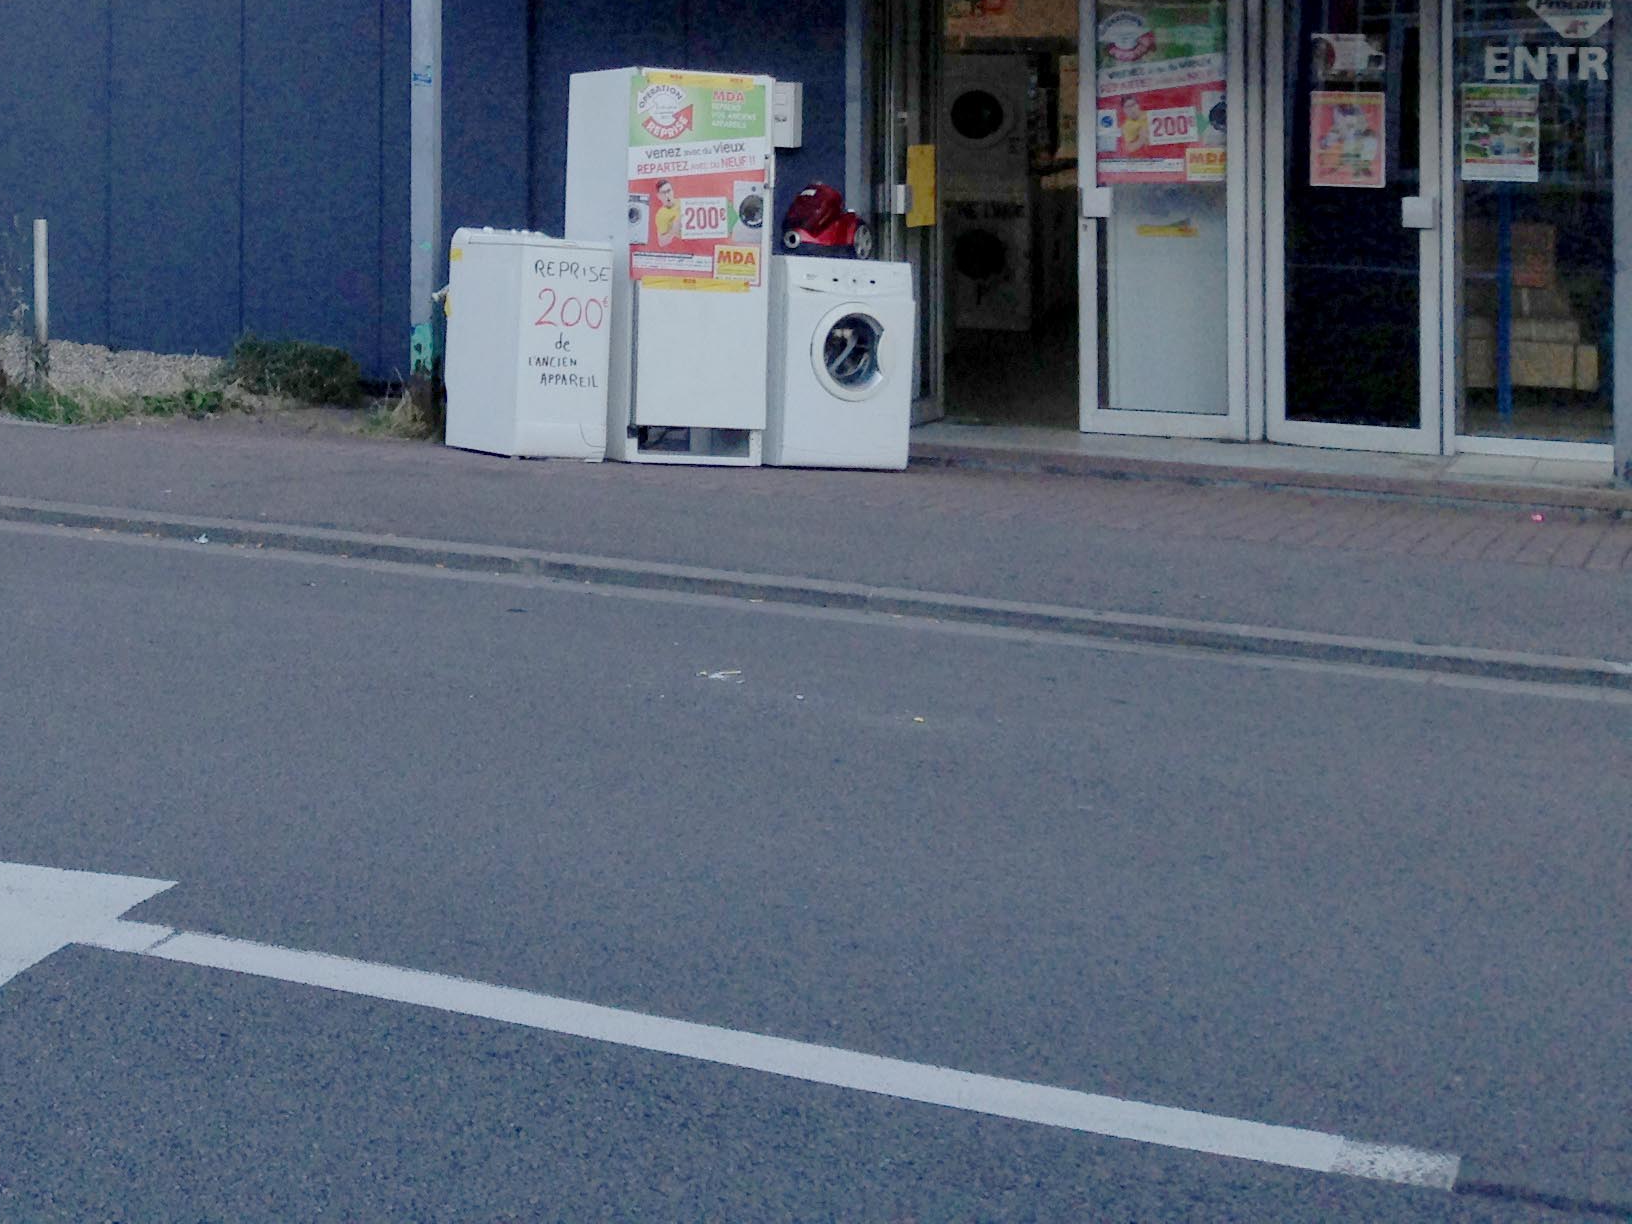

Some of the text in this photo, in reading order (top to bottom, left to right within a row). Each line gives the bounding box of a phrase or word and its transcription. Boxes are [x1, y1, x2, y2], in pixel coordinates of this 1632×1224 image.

[1484, 46, 1608, 80] ENTR
[712, 89, 745, 104] MDA
[647, 116, 689, 138] REPRISE
[645, 147, 681, 159] venez
[713, 141, 745, 154] vieux
[637, 161, 688, 175] REPARTEZ
[721, 157, 746, 168] NEUF
[685, 207, 726, 230] 200€
[717, 250, 756, 265] MDA
[535, 259, 611, 282] REPRISE
[535, 288, 608, 329] 200€
[555, 332, 571, 352] de
[540, 373, 599, 388] APPAREIL
